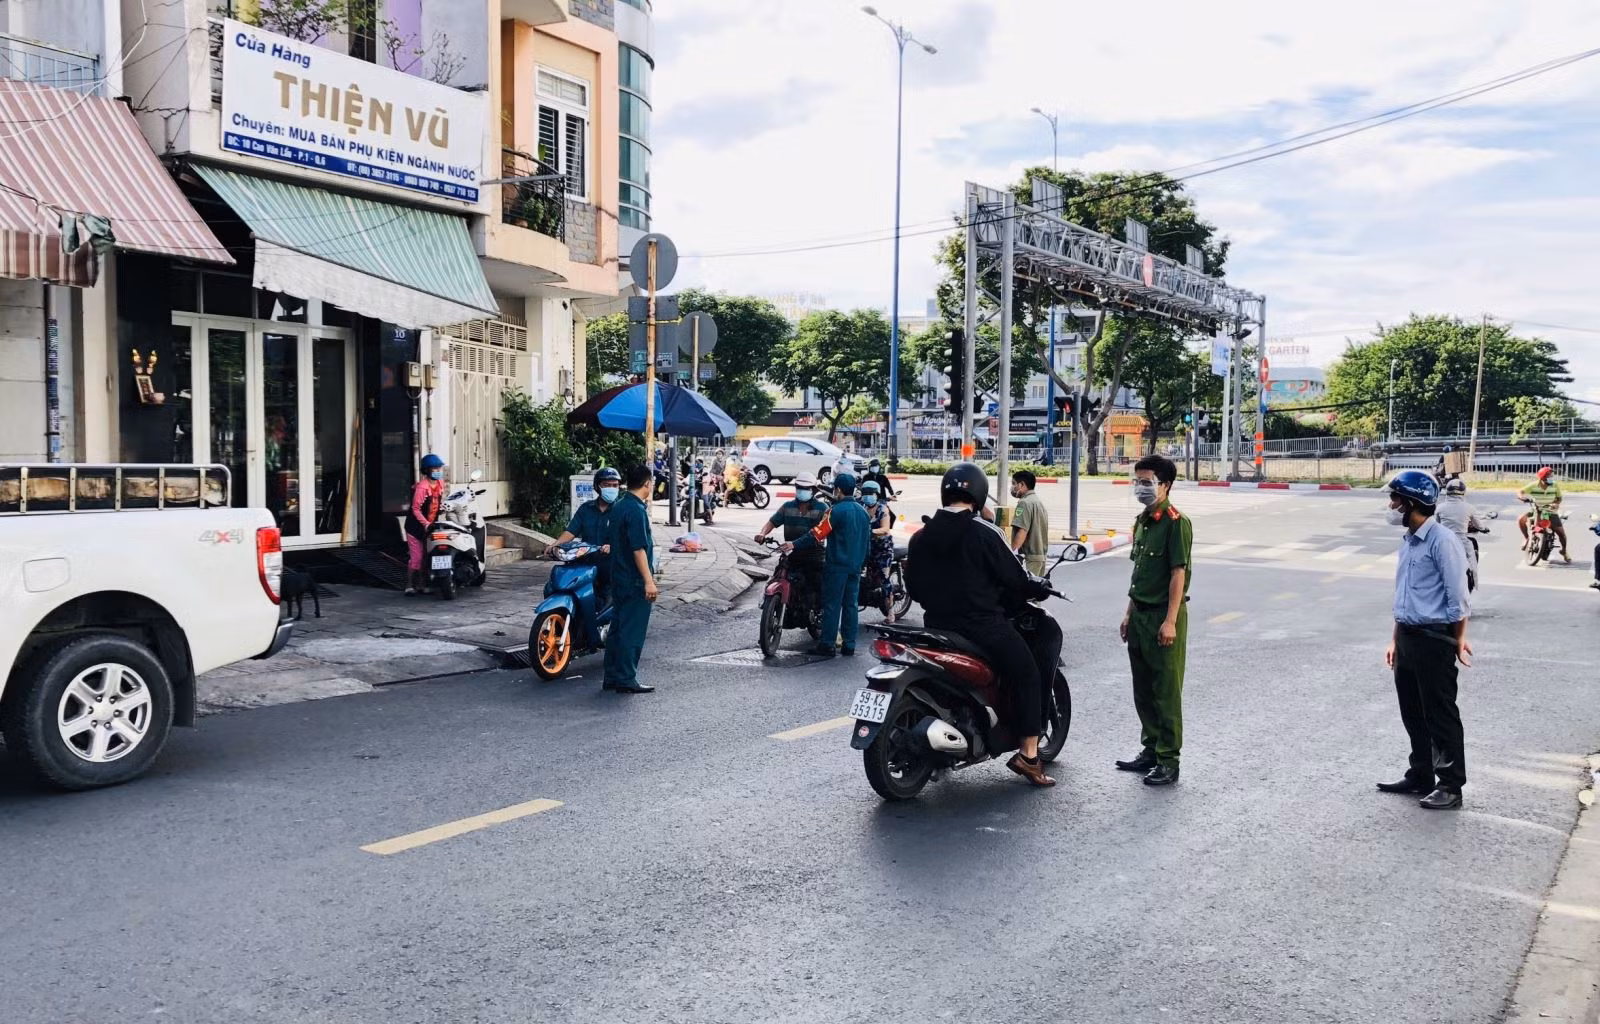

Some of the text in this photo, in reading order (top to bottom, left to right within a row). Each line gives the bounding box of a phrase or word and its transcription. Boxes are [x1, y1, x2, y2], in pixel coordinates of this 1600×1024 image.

[235, 33, 311, 69] Cửa Hàng
[273, 70, 449, 149] THIỆN VŨ
[232, 112, 476, 181] Chuyên: MUA BÁN PHỤ KIỆN NGÀNH NƯỚC
[394, 328, 407, 339] 10
[198, 528, 245, 544] 4x4
